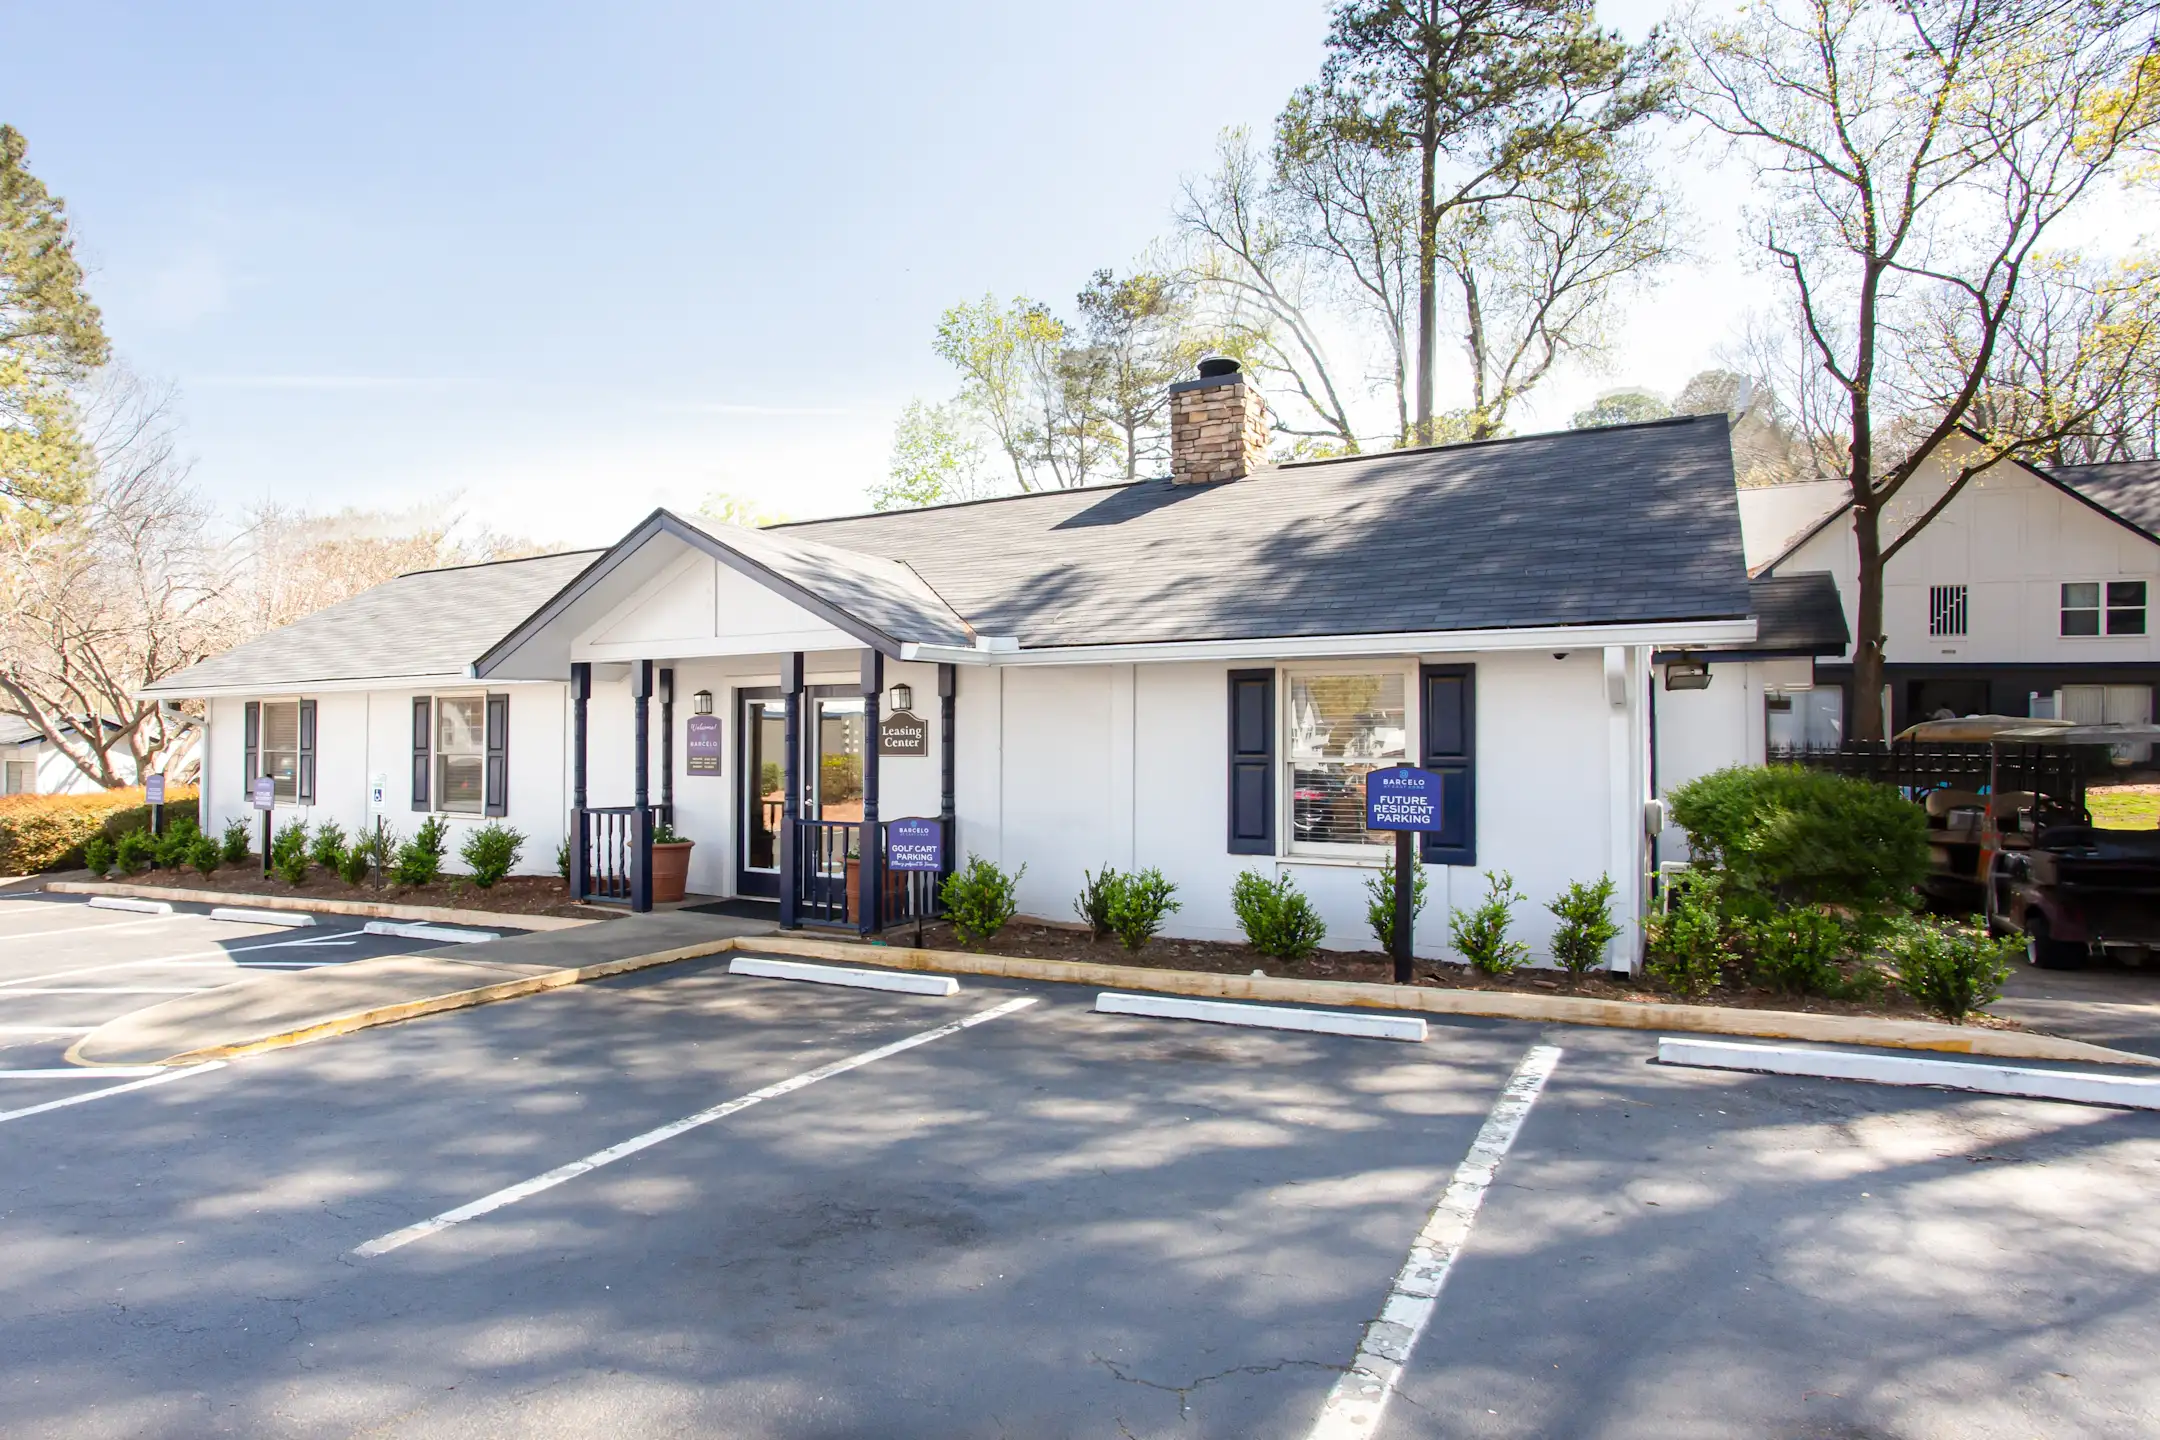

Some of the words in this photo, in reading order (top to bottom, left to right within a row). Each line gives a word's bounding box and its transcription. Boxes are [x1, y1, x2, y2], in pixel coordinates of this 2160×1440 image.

[882, 725, 922, 739] Leasing
[884, 736, 920, 747] Center
[1379, 795, 1428, 806] FUTURE
[1373, 804, 1435, 815] RESIDENT
[1376, 813, 1431, 824] PARKING
[891, 844, 914, 852] GOLF
[914, 845, 938, 853] CART
[896, 853, 933, 861] PARKING
